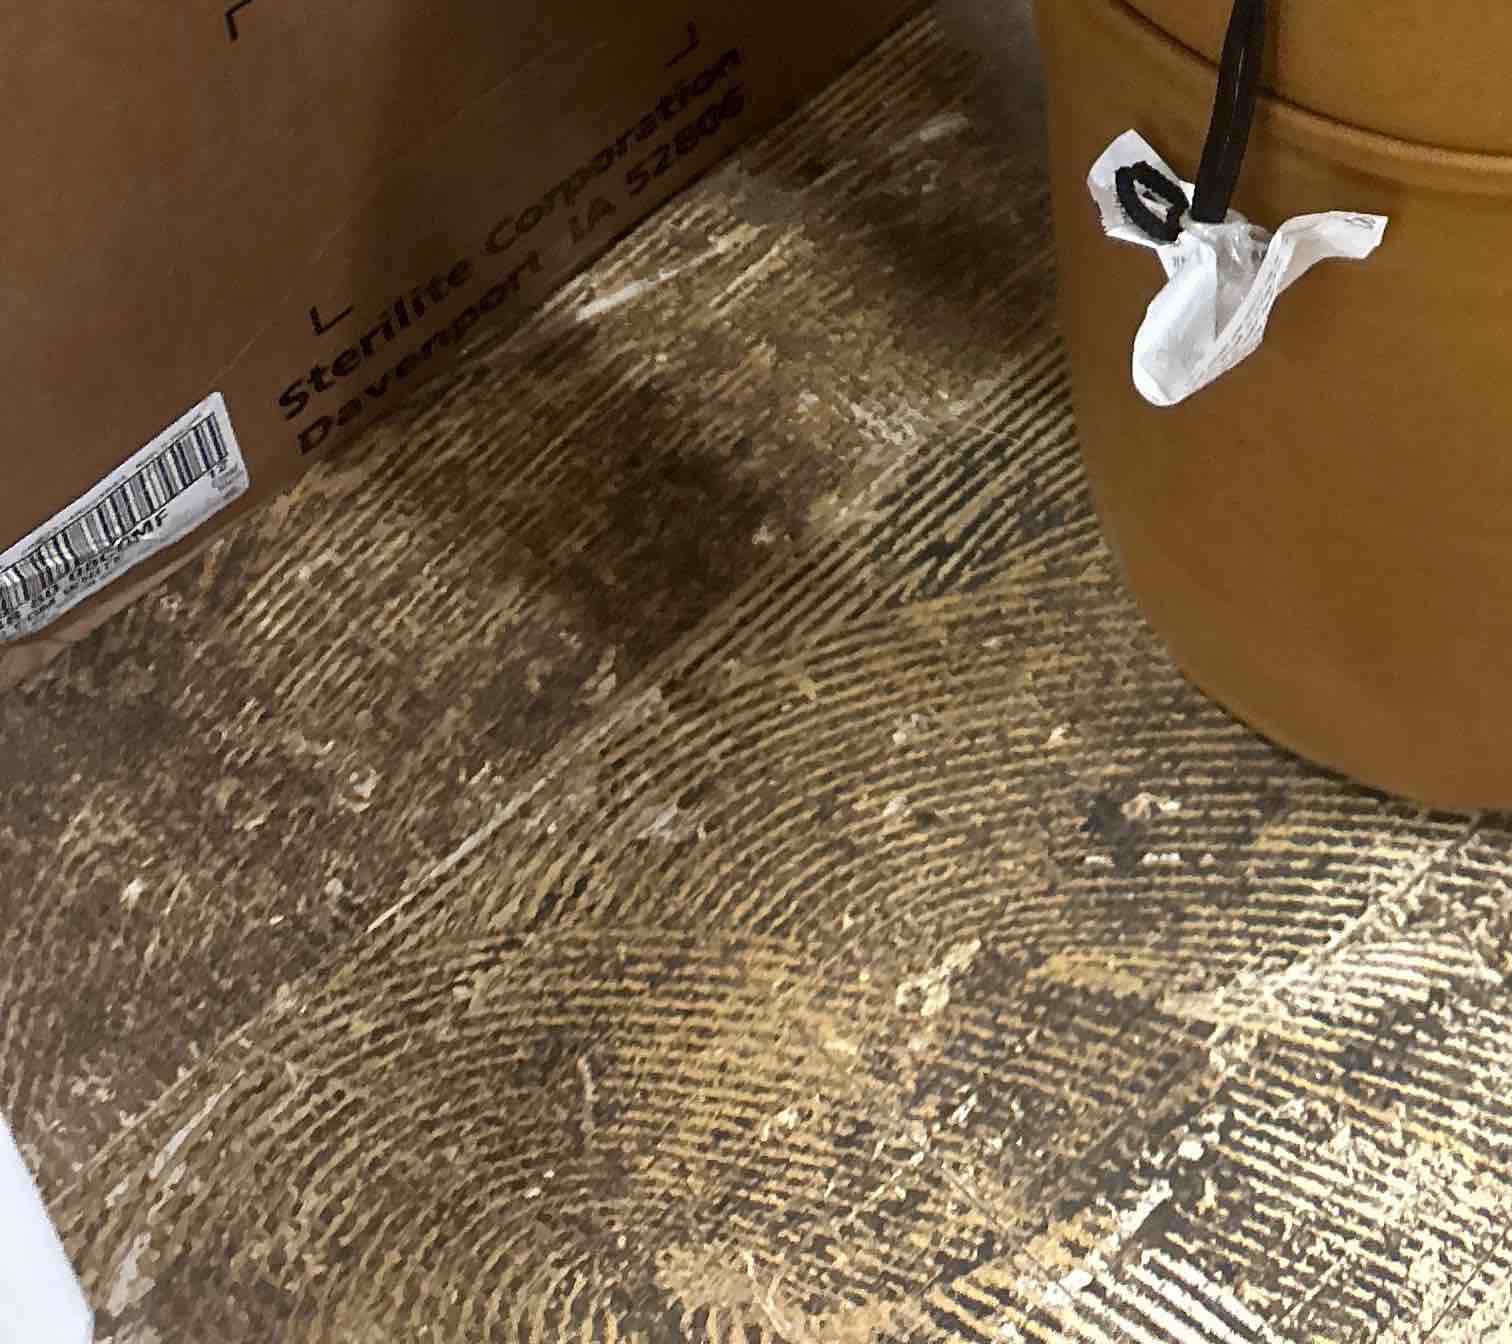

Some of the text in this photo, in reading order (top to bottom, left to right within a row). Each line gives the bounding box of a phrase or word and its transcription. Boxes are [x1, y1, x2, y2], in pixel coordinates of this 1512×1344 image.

[279, 46, 742, 421] Sterilite Corporation
[297, 251, 544, 456] Davenport
